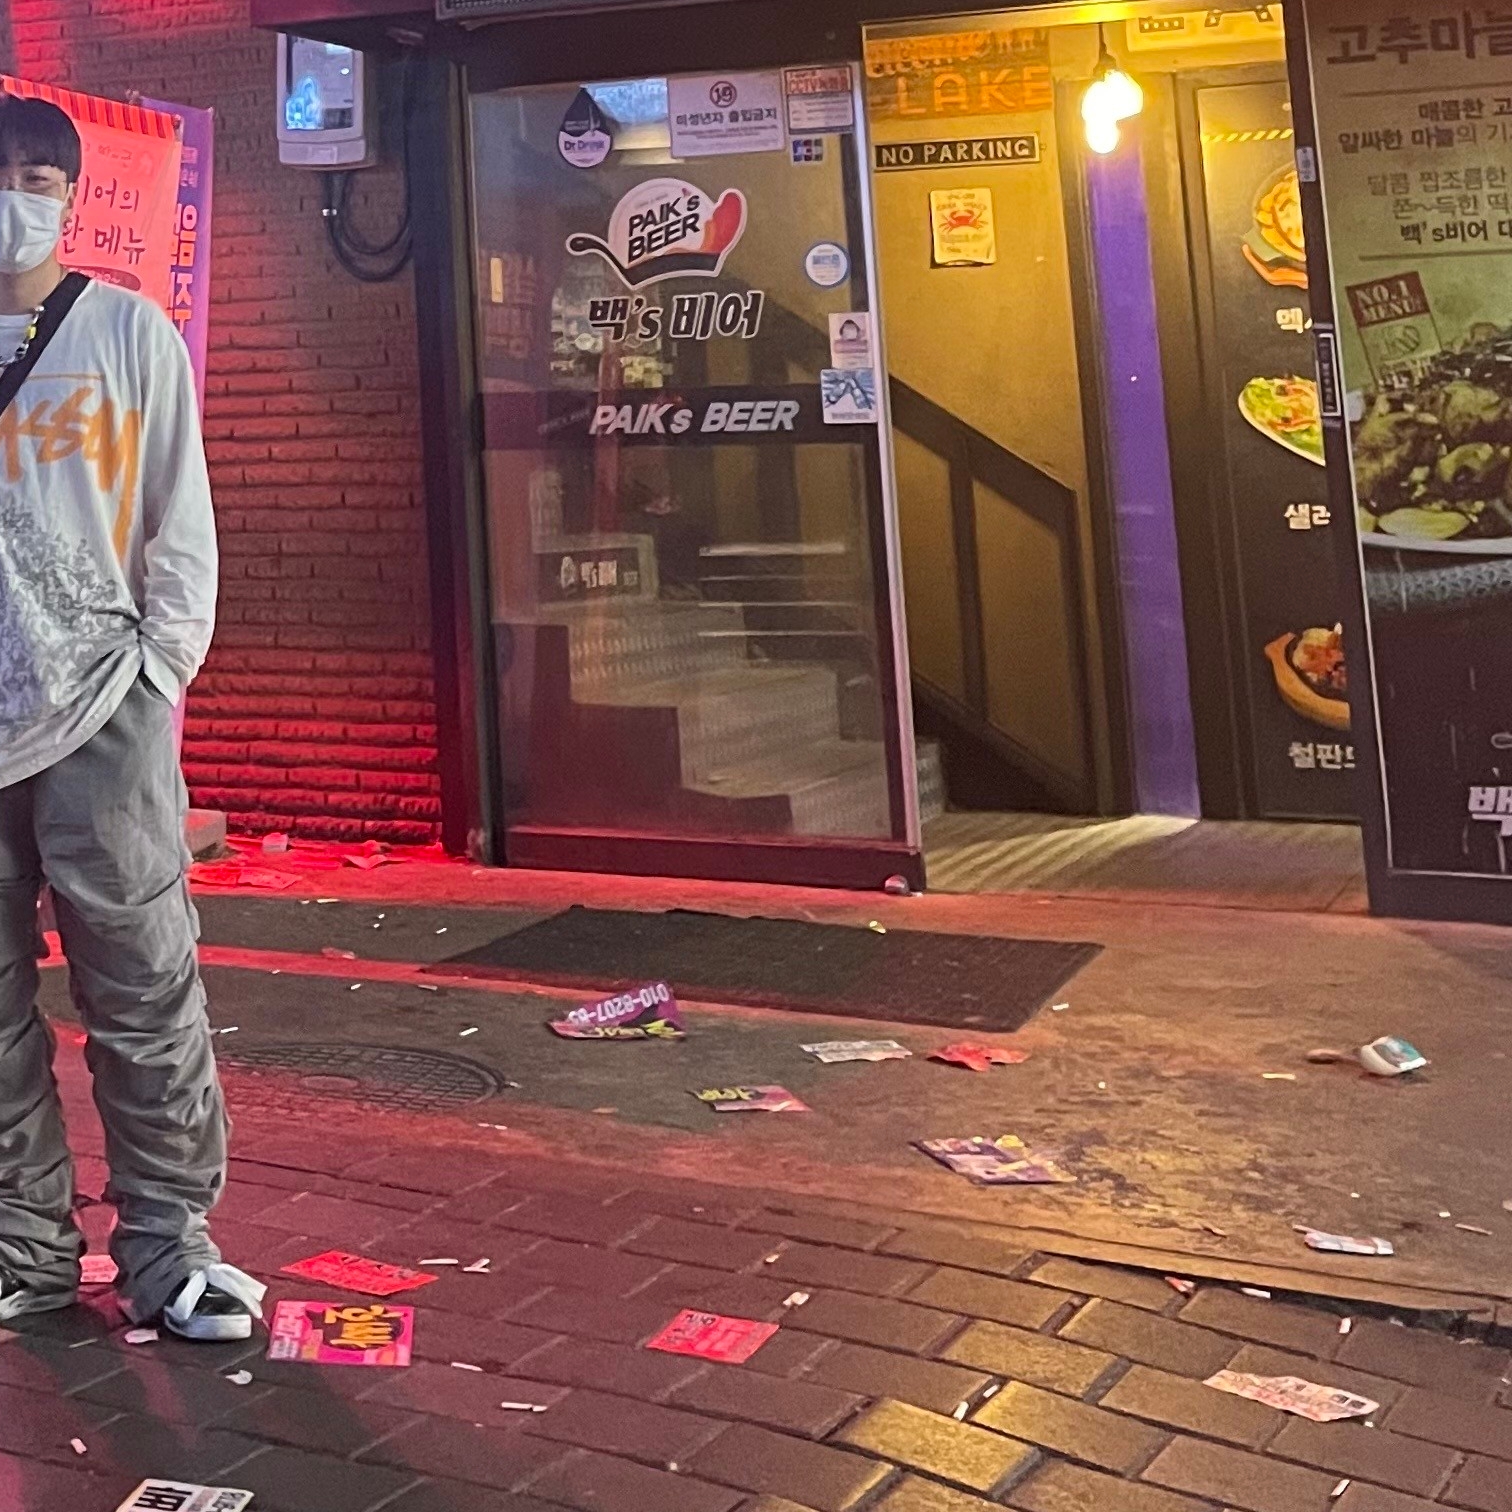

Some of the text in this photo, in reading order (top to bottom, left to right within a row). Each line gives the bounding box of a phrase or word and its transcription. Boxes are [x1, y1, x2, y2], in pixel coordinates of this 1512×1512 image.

[897, 65, 1054, 115] LAKE
[881, 138, 1031, 165] NO PARKING
[94, 223, 147, 265] 메뉴
[628, 213, 701, 264] BEER
[588, 290, 765, 342] 백's 비어
[700, 399, 801, 433] BEER
